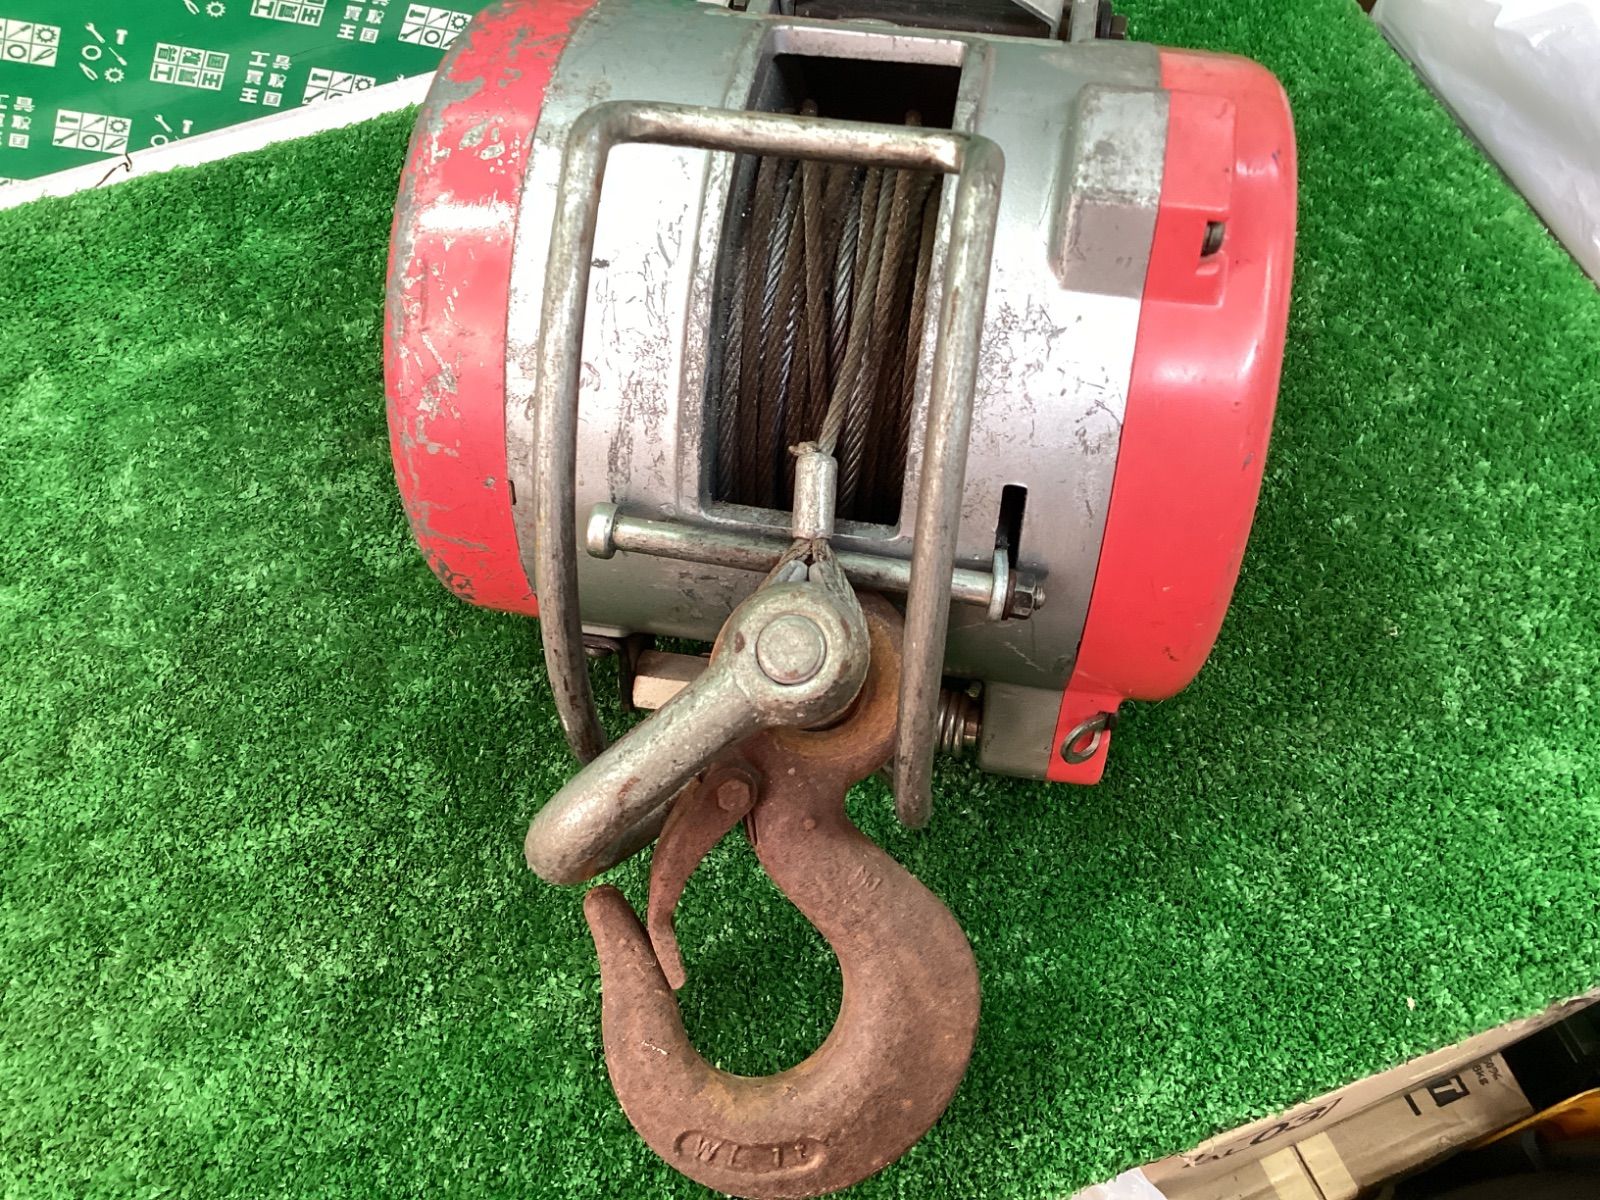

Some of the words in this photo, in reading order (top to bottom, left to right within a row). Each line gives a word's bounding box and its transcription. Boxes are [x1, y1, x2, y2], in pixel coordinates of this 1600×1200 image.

[337, 23, 380, 44] 王国
[248, 51, 292, 71] 工具
[239, 87, 283, 107] 王国
[0, 113, 32, 130] 取
